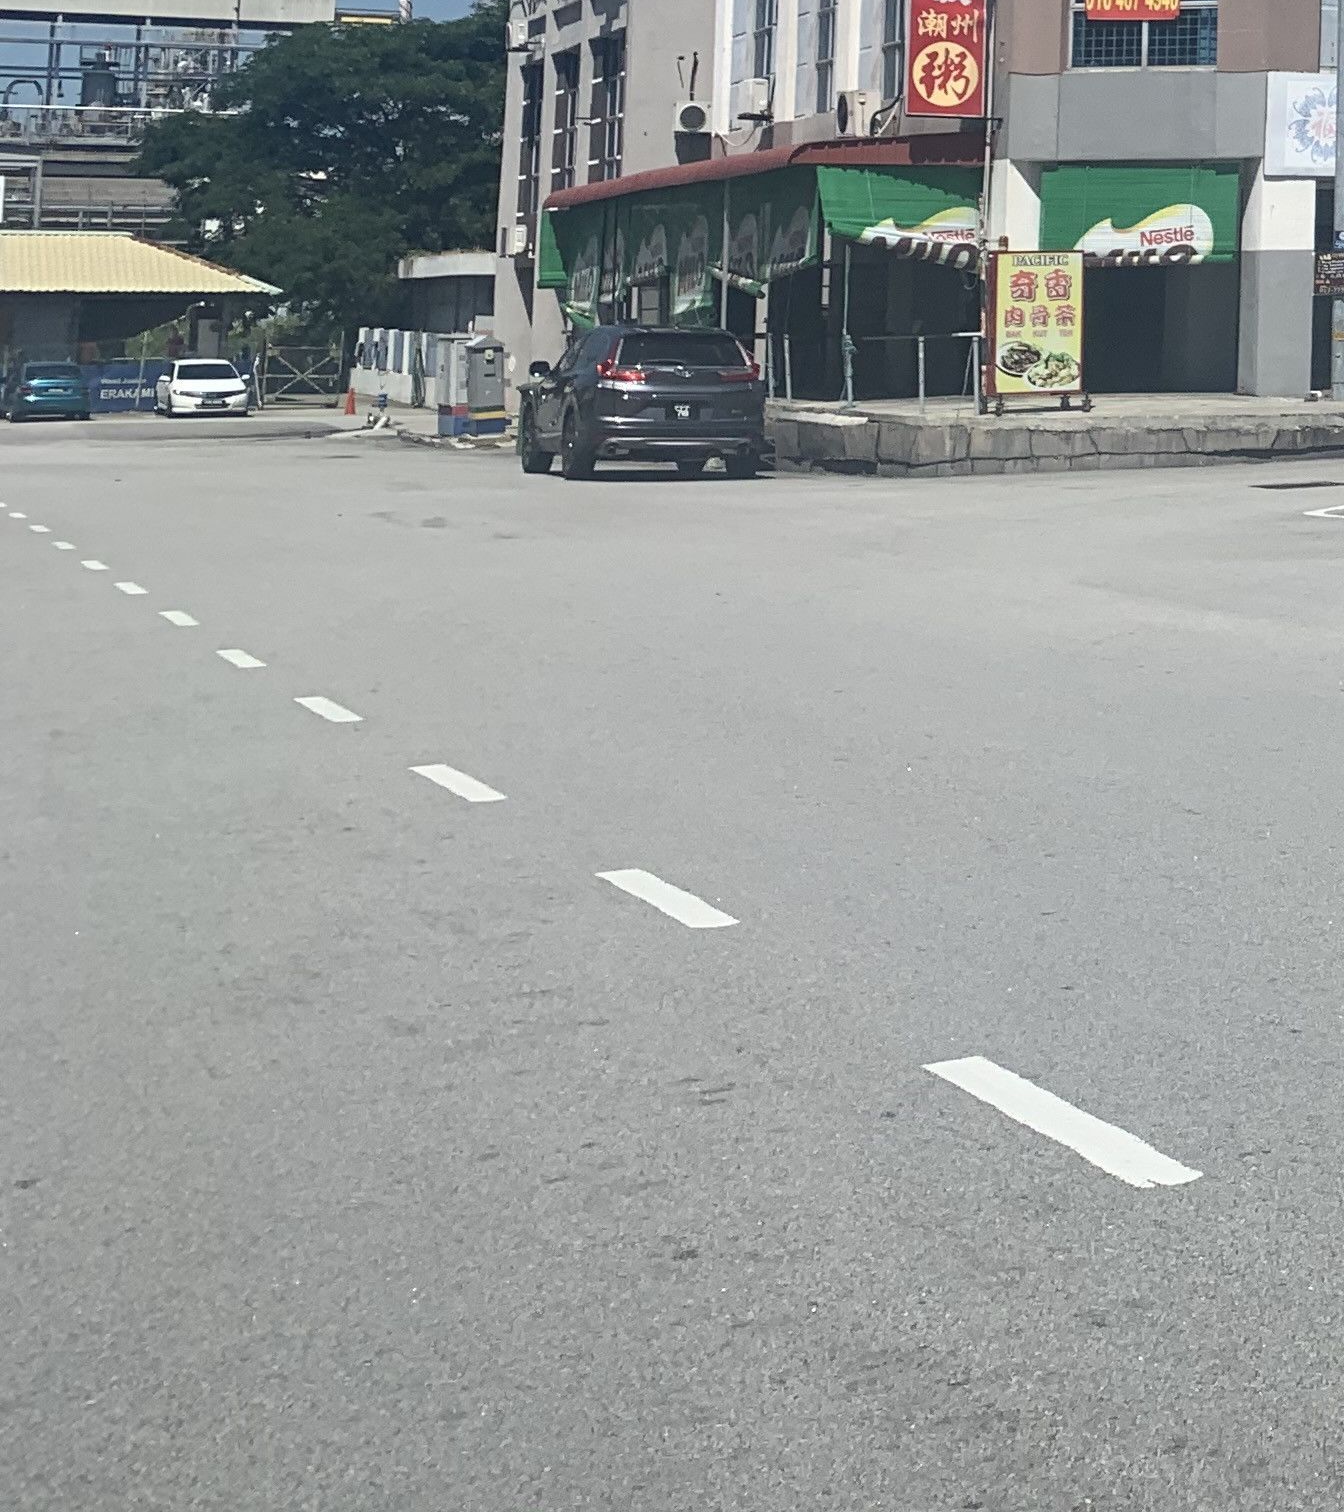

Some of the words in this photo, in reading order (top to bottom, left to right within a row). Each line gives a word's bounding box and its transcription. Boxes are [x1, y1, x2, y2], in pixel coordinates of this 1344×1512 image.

[917, 8, 980, 43] 潮州
[919, 47, 971, 100] 粥
[1012, 254, 1069, 266] PACIFIC
